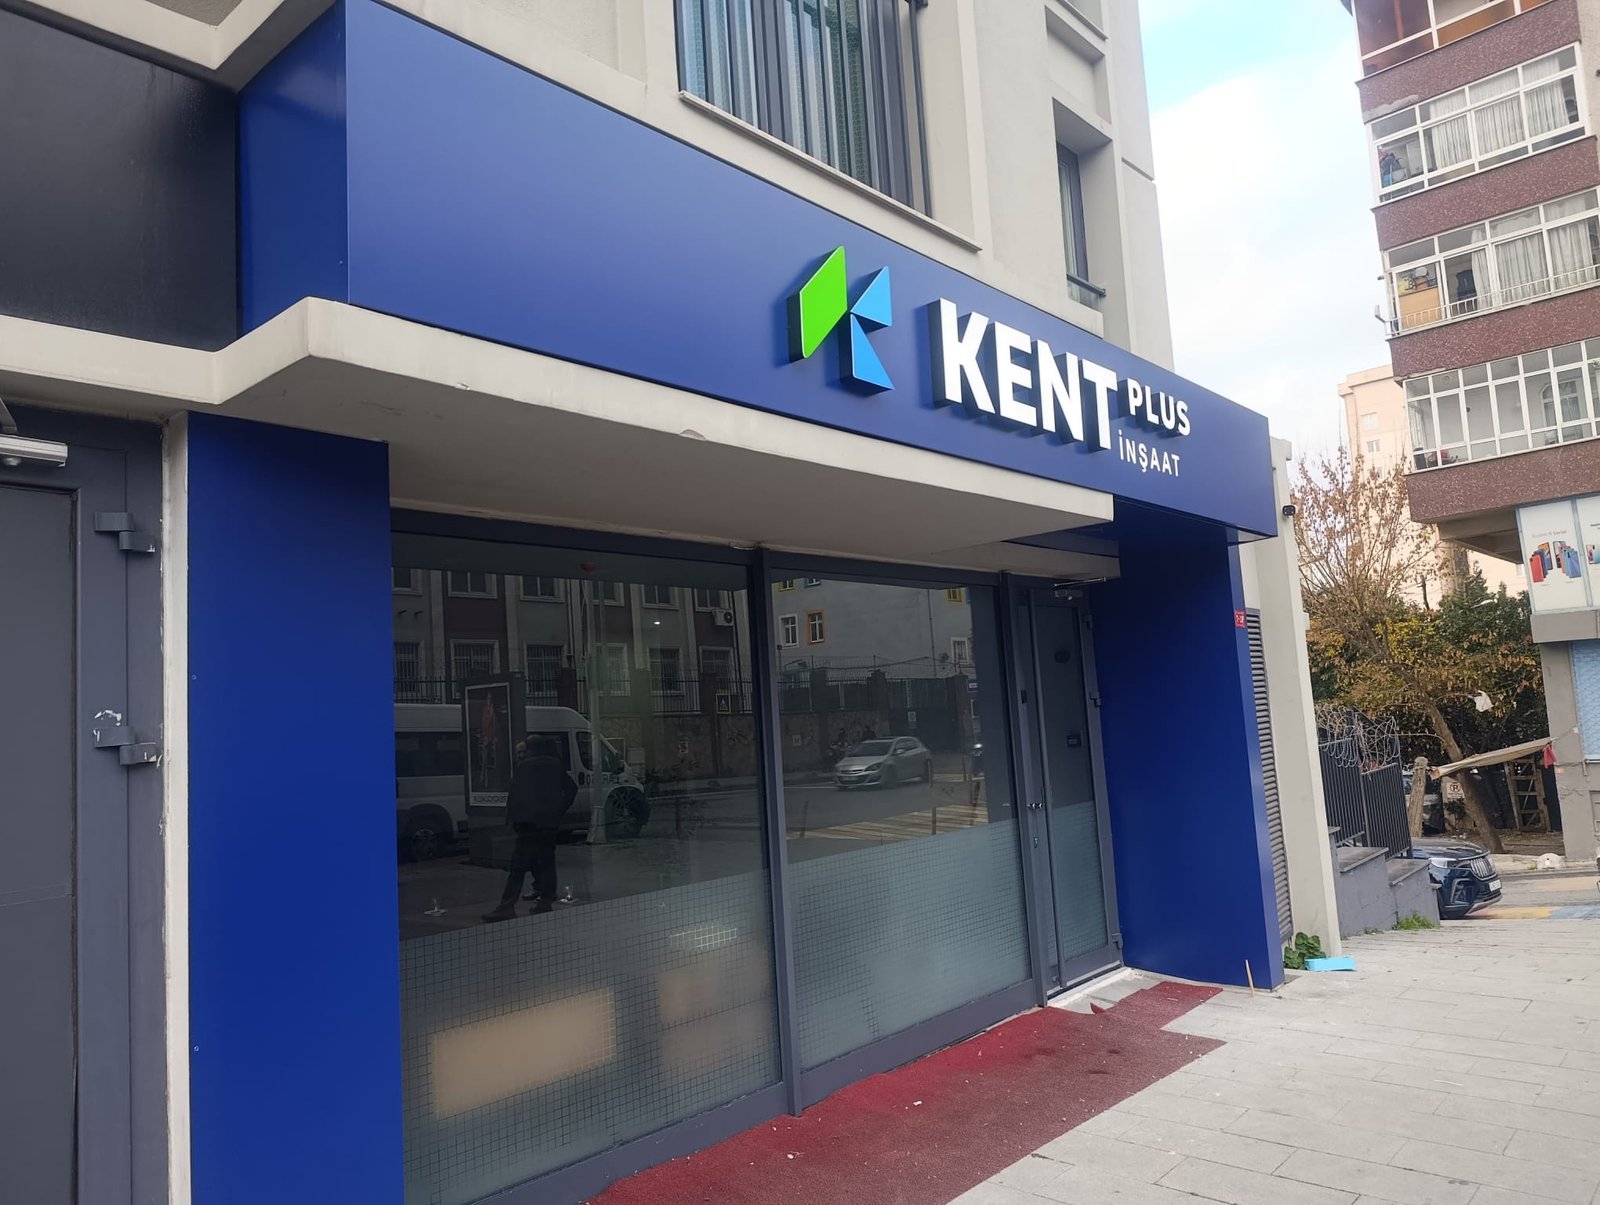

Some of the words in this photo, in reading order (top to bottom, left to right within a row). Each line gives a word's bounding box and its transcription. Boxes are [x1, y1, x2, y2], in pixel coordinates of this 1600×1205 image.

[939, 297, 1118, 450] KENT
[1126, 378, 1191, 437] PLUS
[1118, 429, 1181, 478] İNŞAAT
